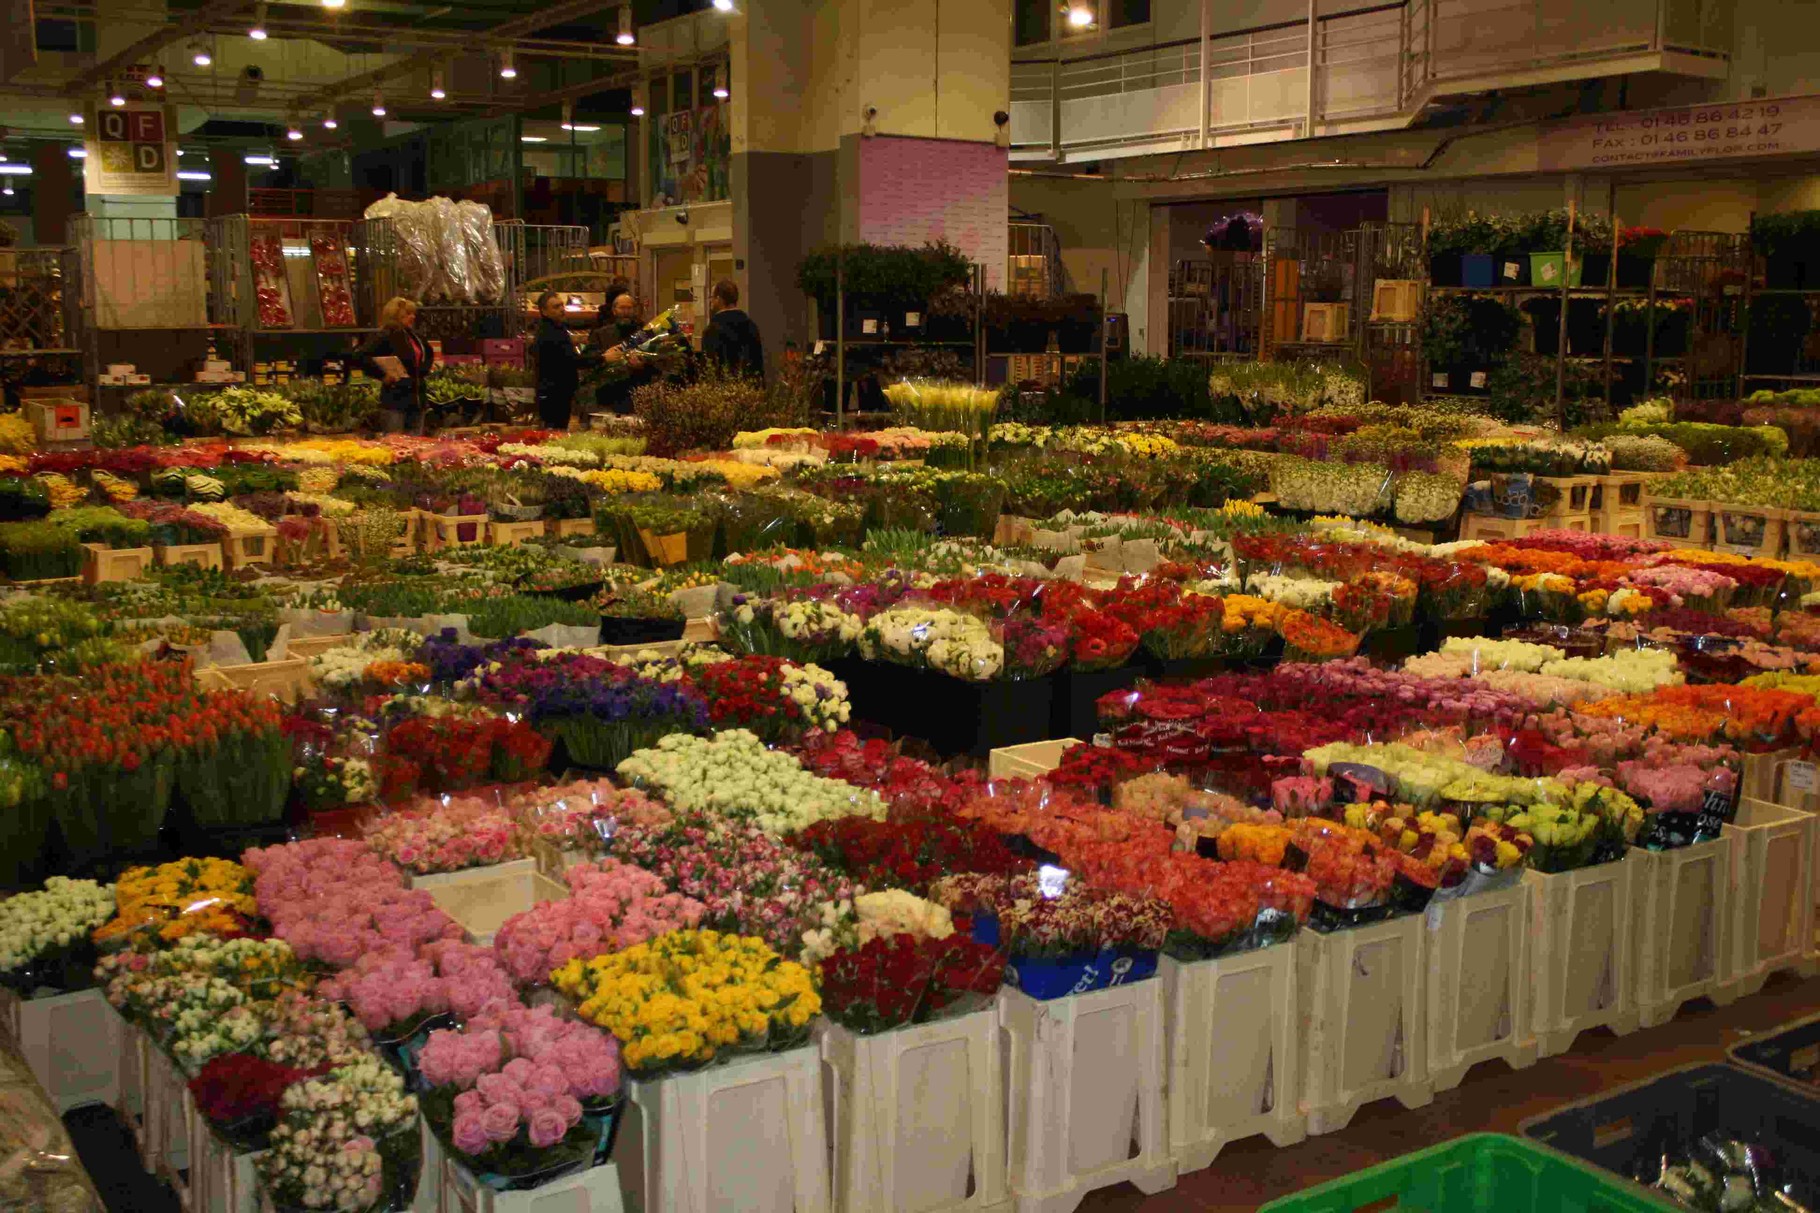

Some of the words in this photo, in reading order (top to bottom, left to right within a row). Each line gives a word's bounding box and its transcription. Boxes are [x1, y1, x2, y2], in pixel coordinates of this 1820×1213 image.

[1728, 108, 1754, 120] 42
[1760, 105, 1780, 117] 19
[105, 113, 125, 139] Q
[138, 115, 154, 137] F
[1641, 134, 1658, 145] 01
[1664, 131, 1688, 142] 46
[1694, 127, 1720, 141] 86
[1726, 126, 1752, 138] 84
[1758, 122, 1783, 135] 47
[139, 145, 159, 169] D
